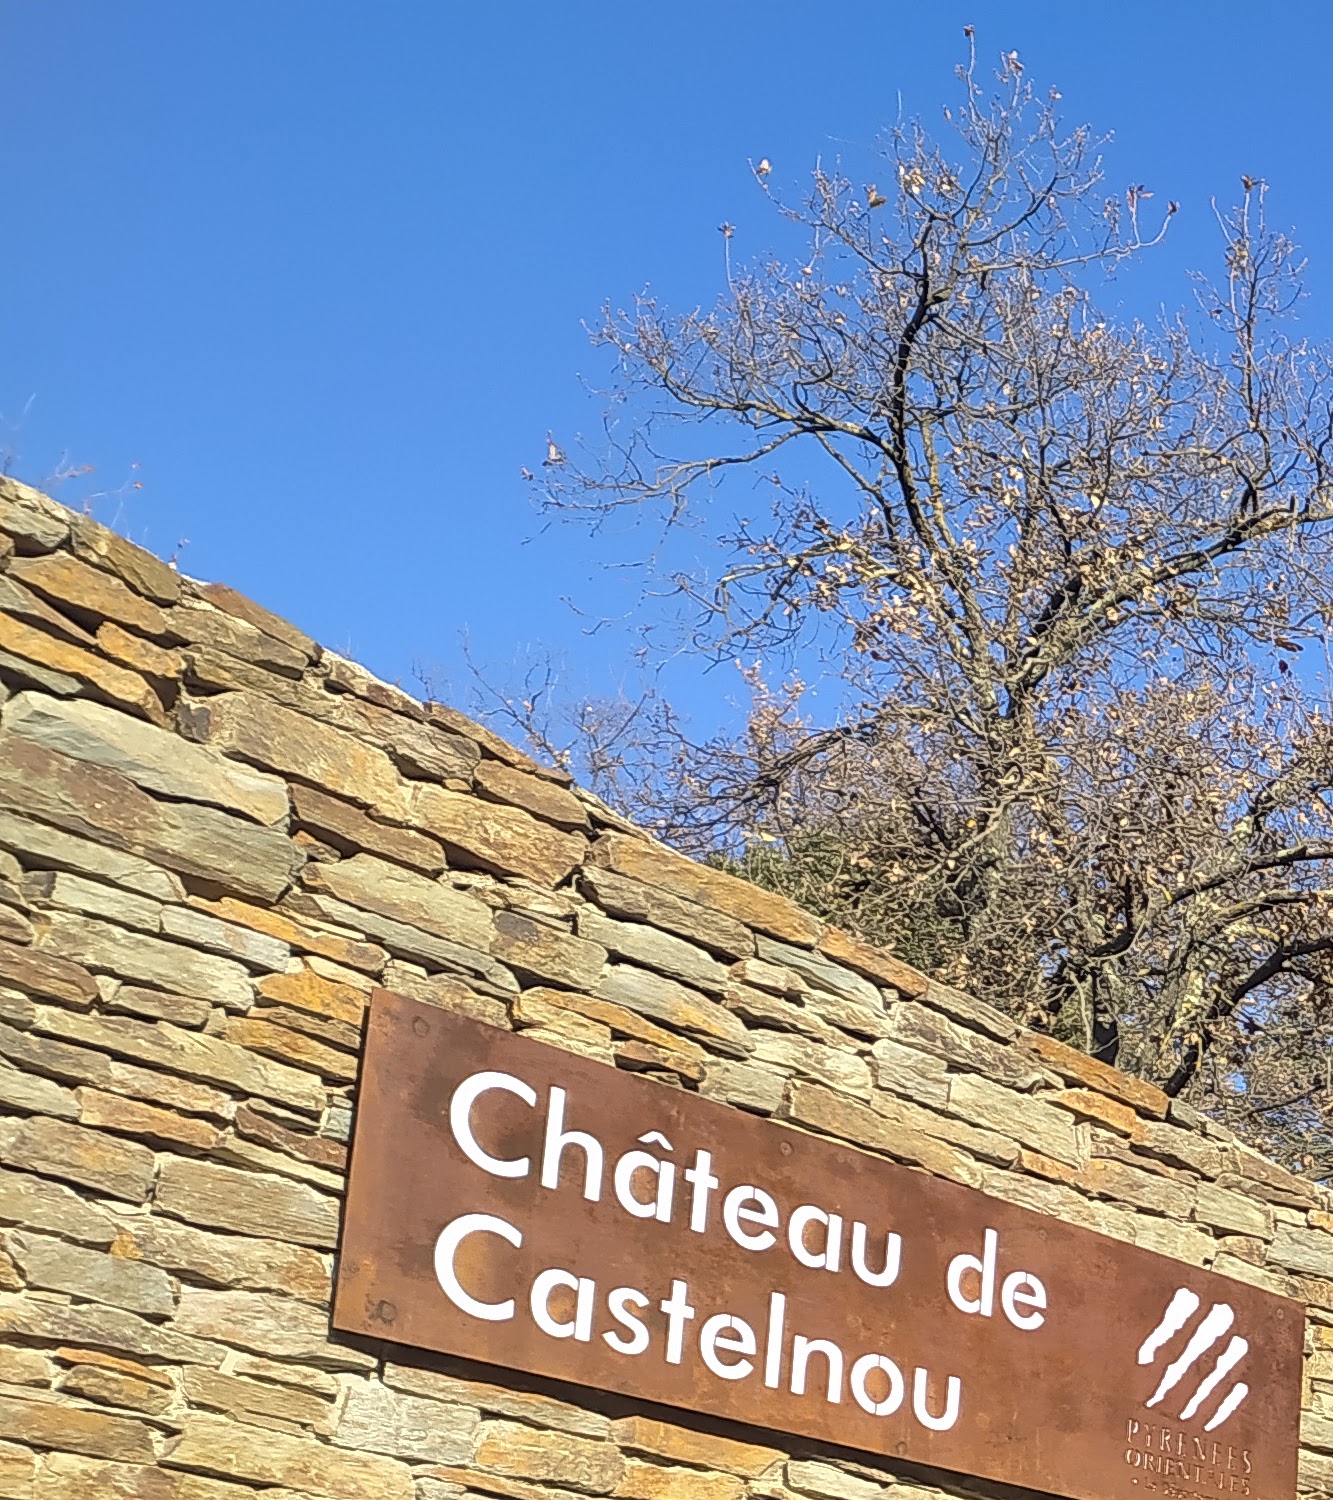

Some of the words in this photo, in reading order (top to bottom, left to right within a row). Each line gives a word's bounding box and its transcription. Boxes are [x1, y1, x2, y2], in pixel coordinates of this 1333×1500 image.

[449, 1071, 902, 1288] Château
[946, 1228, 1047, 1331] de
[434, 1213, 962, 1432] Castelnou
[1125, 1448, 1251, 1496] ORIENTALES
